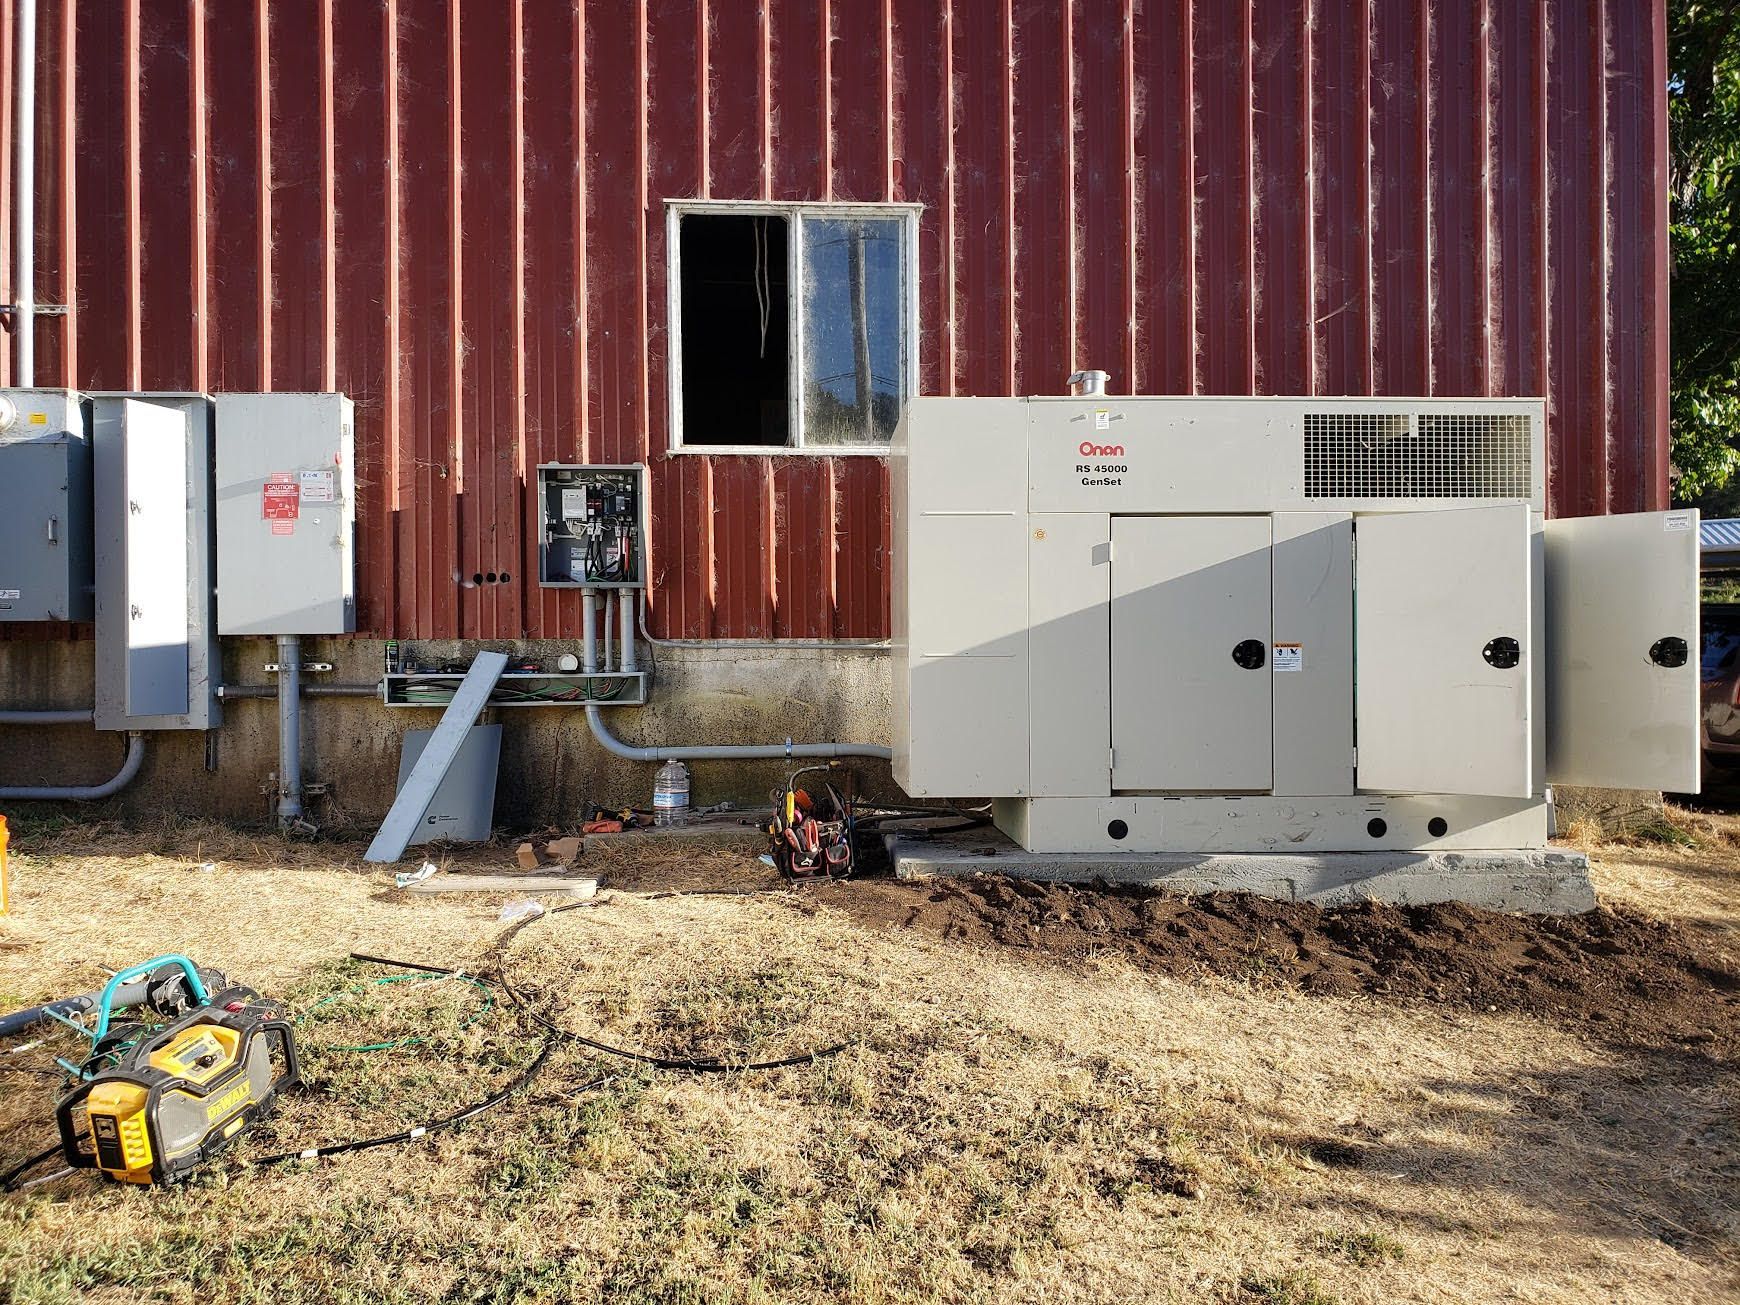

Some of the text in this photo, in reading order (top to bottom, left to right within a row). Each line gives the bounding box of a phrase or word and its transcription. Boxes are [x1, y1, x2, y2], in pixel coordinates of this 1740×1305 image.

[1079, 441, 1124, 457] Onan
[1075, 464, 1128, 473] RS 45000
[1081, 477, 1122, 486] GenSet
